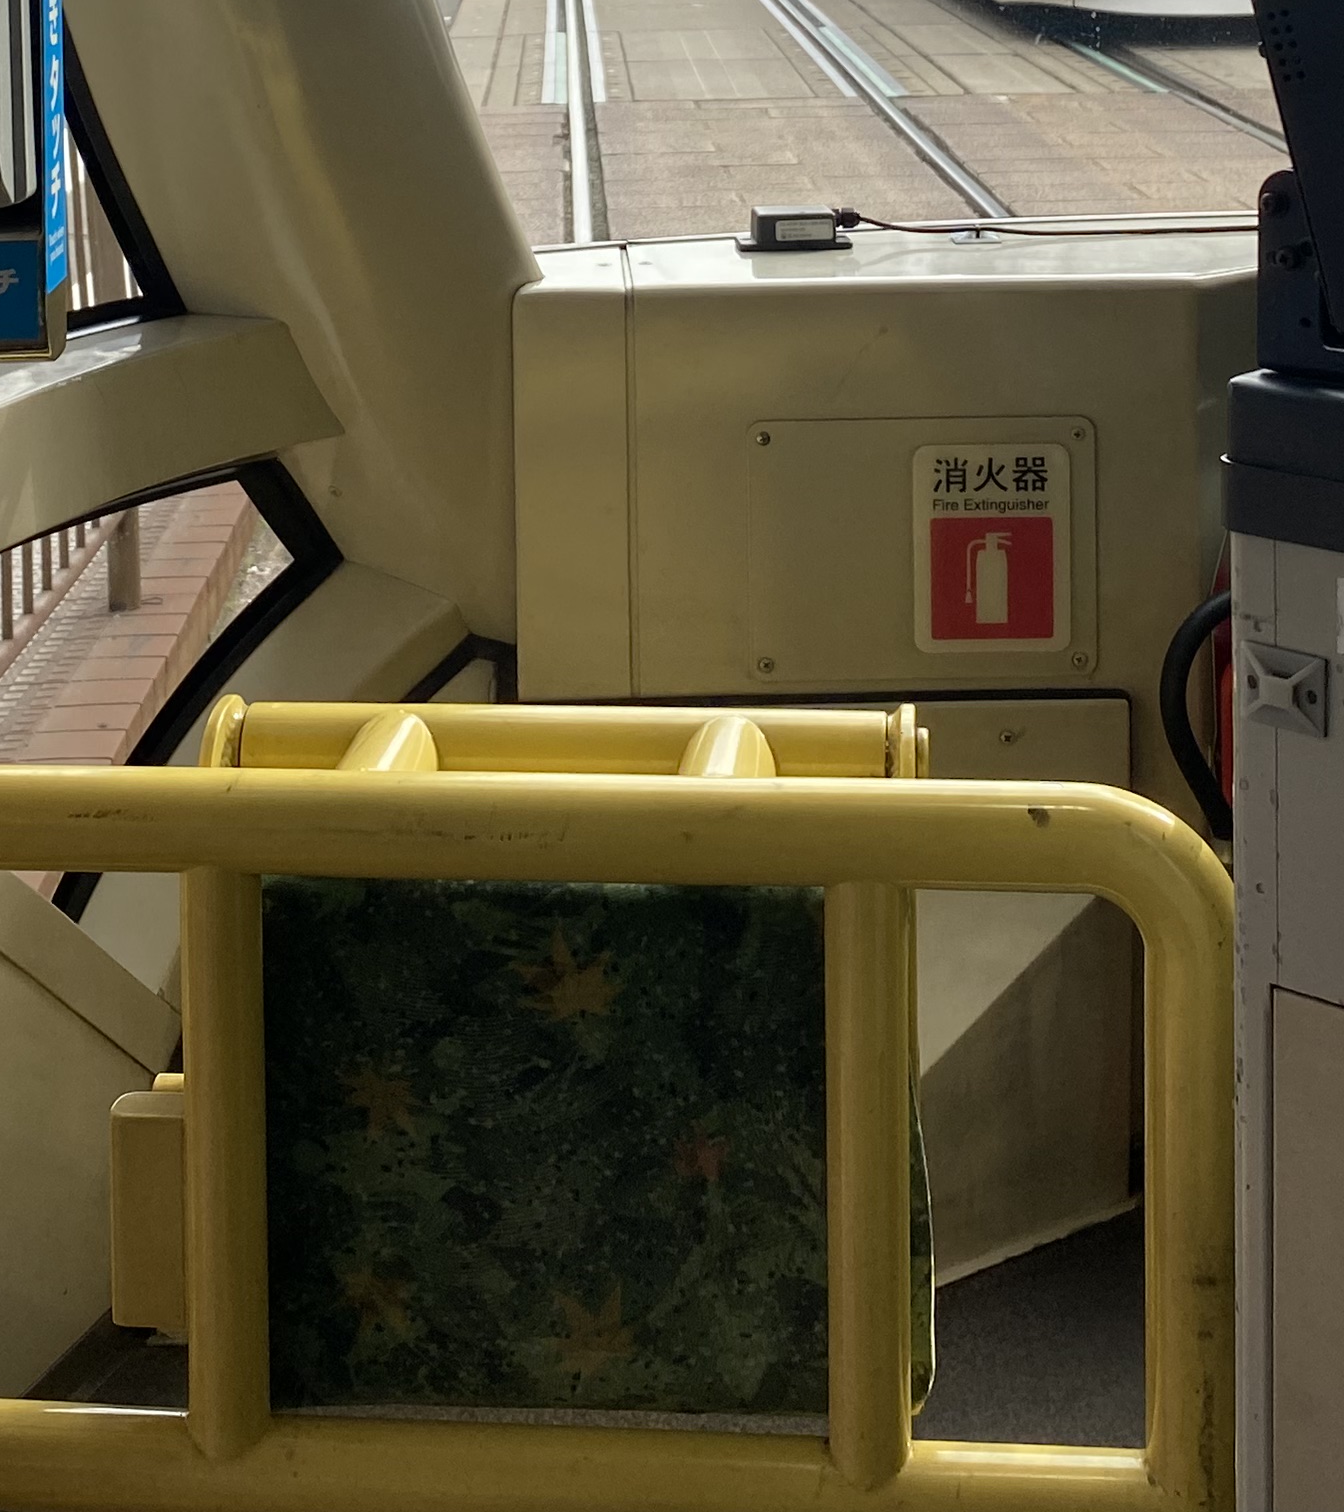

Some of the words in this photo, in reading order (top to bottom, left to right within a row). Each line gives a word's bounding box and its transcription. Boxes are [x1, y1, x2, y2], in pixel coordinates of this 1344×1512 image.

[932, 456, 1049, 493] 消火器
[932, 498, 959, 511] Fire
[963, 498, 1050, 513] Extinguisher
